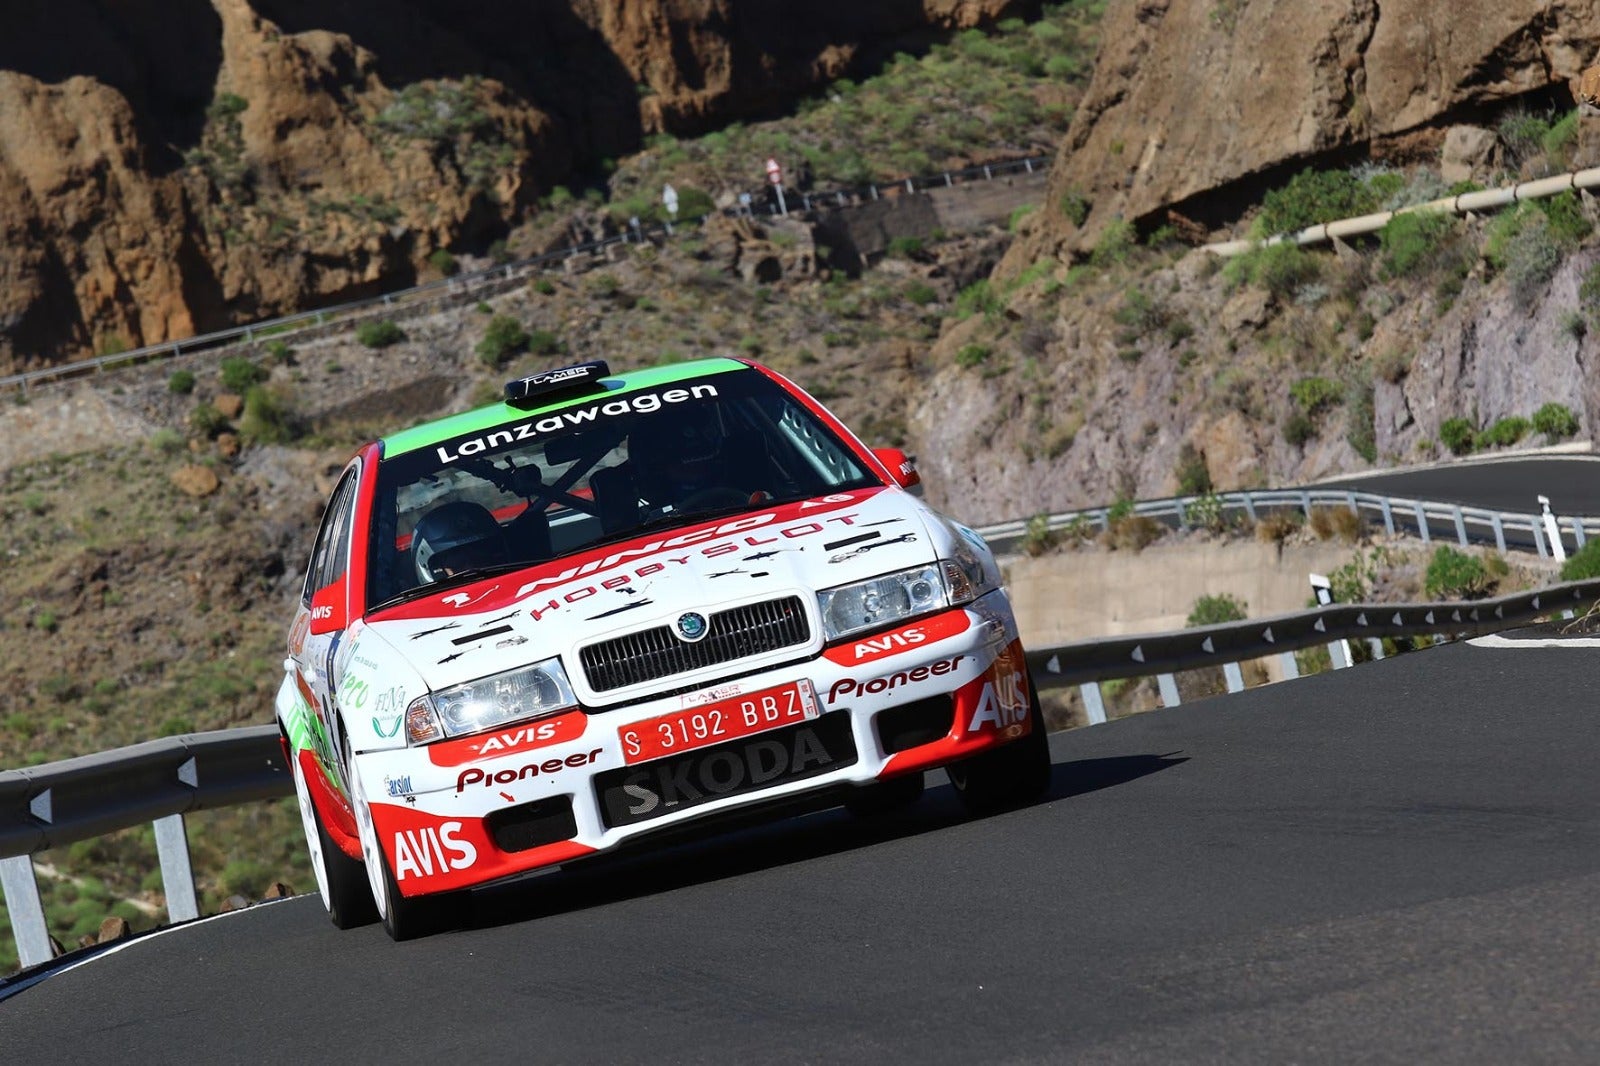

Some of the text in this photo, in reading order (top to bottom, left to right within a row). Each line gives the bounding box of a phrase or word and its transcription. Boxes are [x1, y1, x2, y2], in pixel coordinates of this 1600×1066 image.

[436, 384, 718, 463] Lanzawagen
[515, 513, 776, 598] NINCO
[530, 513, 859, 621] HOBBYSLOT
[312, 605, 333, 620] AVIS
[855, 628, 926, 658] AVIS
[828, 654, 965, 704] Pioneer
[478, 722, 557, 754] AVIS
[624, 689, 801, 756] S 3192 BBZ
[456, 747, 603, 793] Pioneer
[394, 821, 478, 881] AVIS
